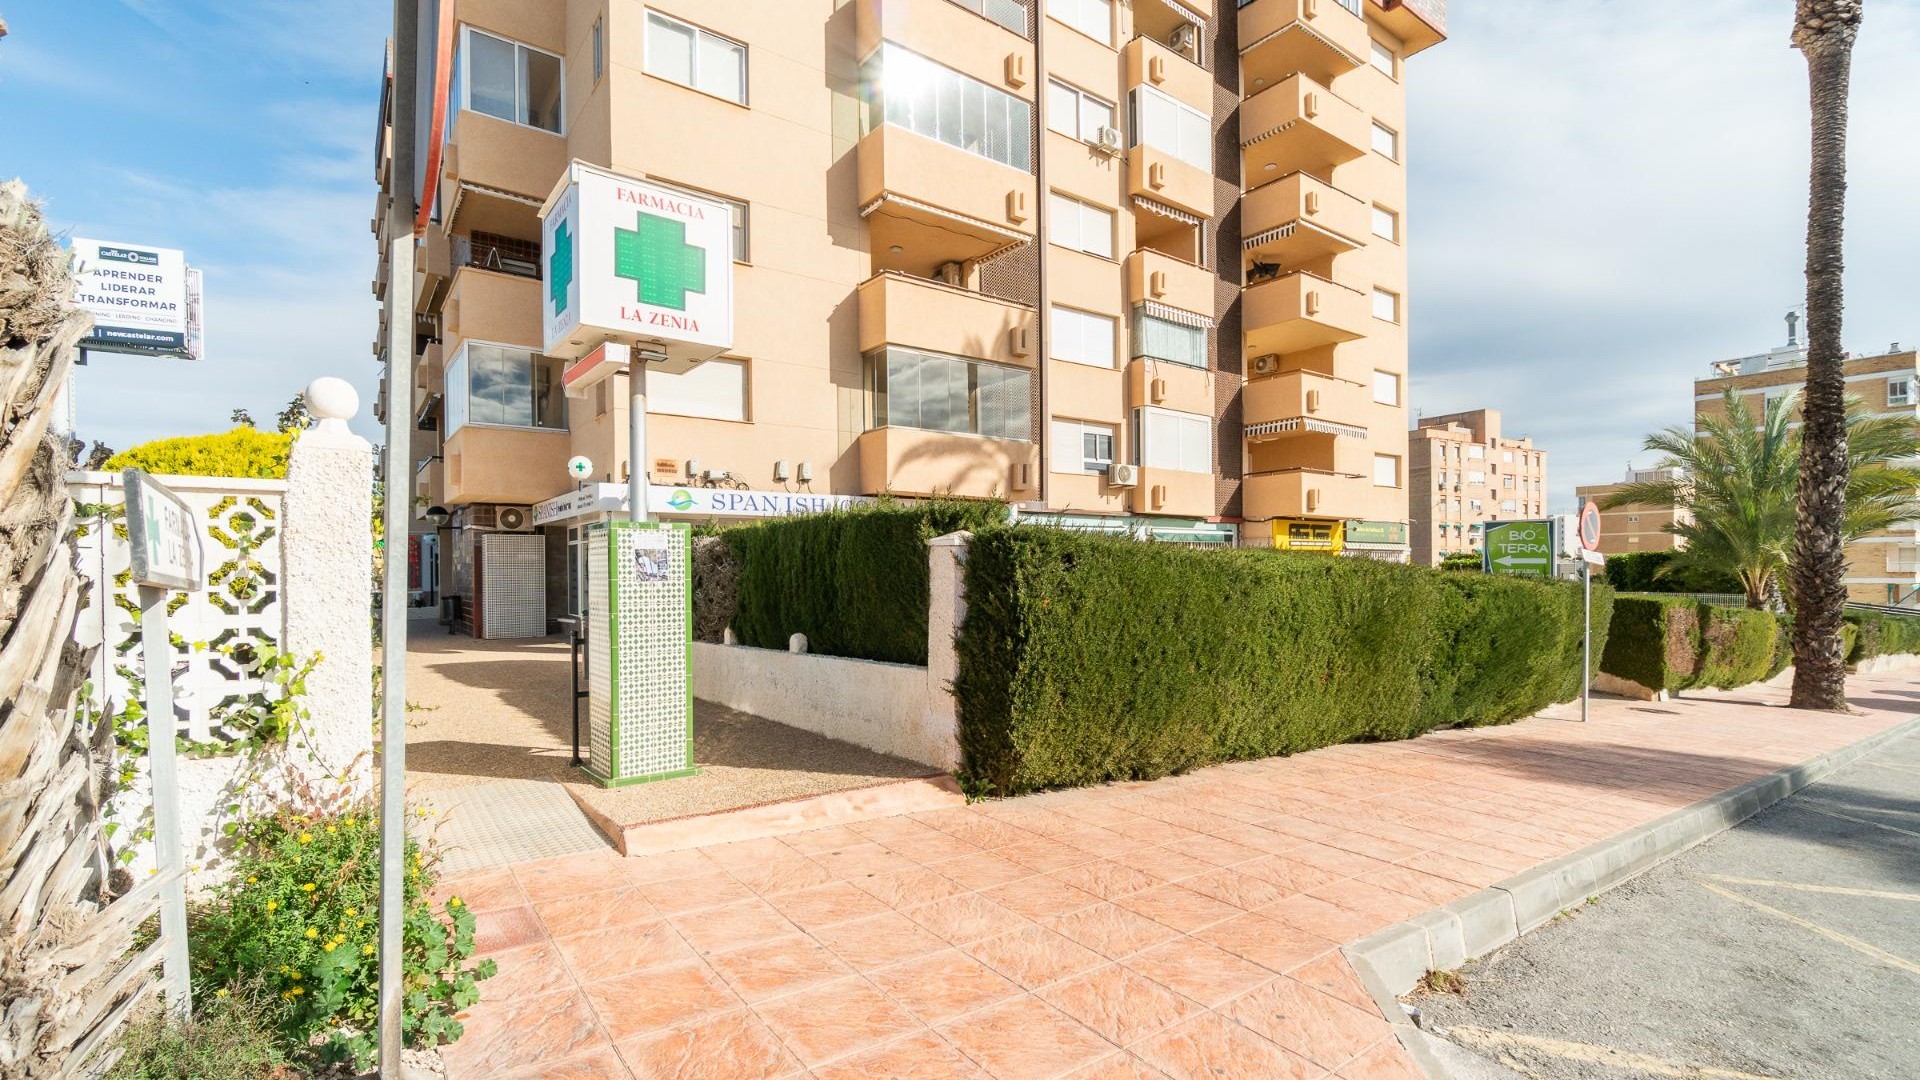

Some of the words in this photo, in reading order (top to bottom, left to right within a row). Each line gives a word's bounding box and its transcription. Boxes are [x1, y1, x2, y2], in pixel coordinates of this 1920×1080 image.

[616, 186, 705, 220] FARMACIA
[93, 269, 163, 283] APRENDER
[101, 282, 156, 296] LIDERAR
[80, 293, 177, 311] TRANSFORMAR
[115, 312, 141, 321] LEADING
[145, 315, 177, 324] CHANGING
[620, 306, 643, 323] LA
[649, 311, 701, 333] ZENIA
[711, 492, 825, 513] SPANISH
[1509, 530, 1536, 541] BIO
[1498, 543, 1549, 554] TERRA
